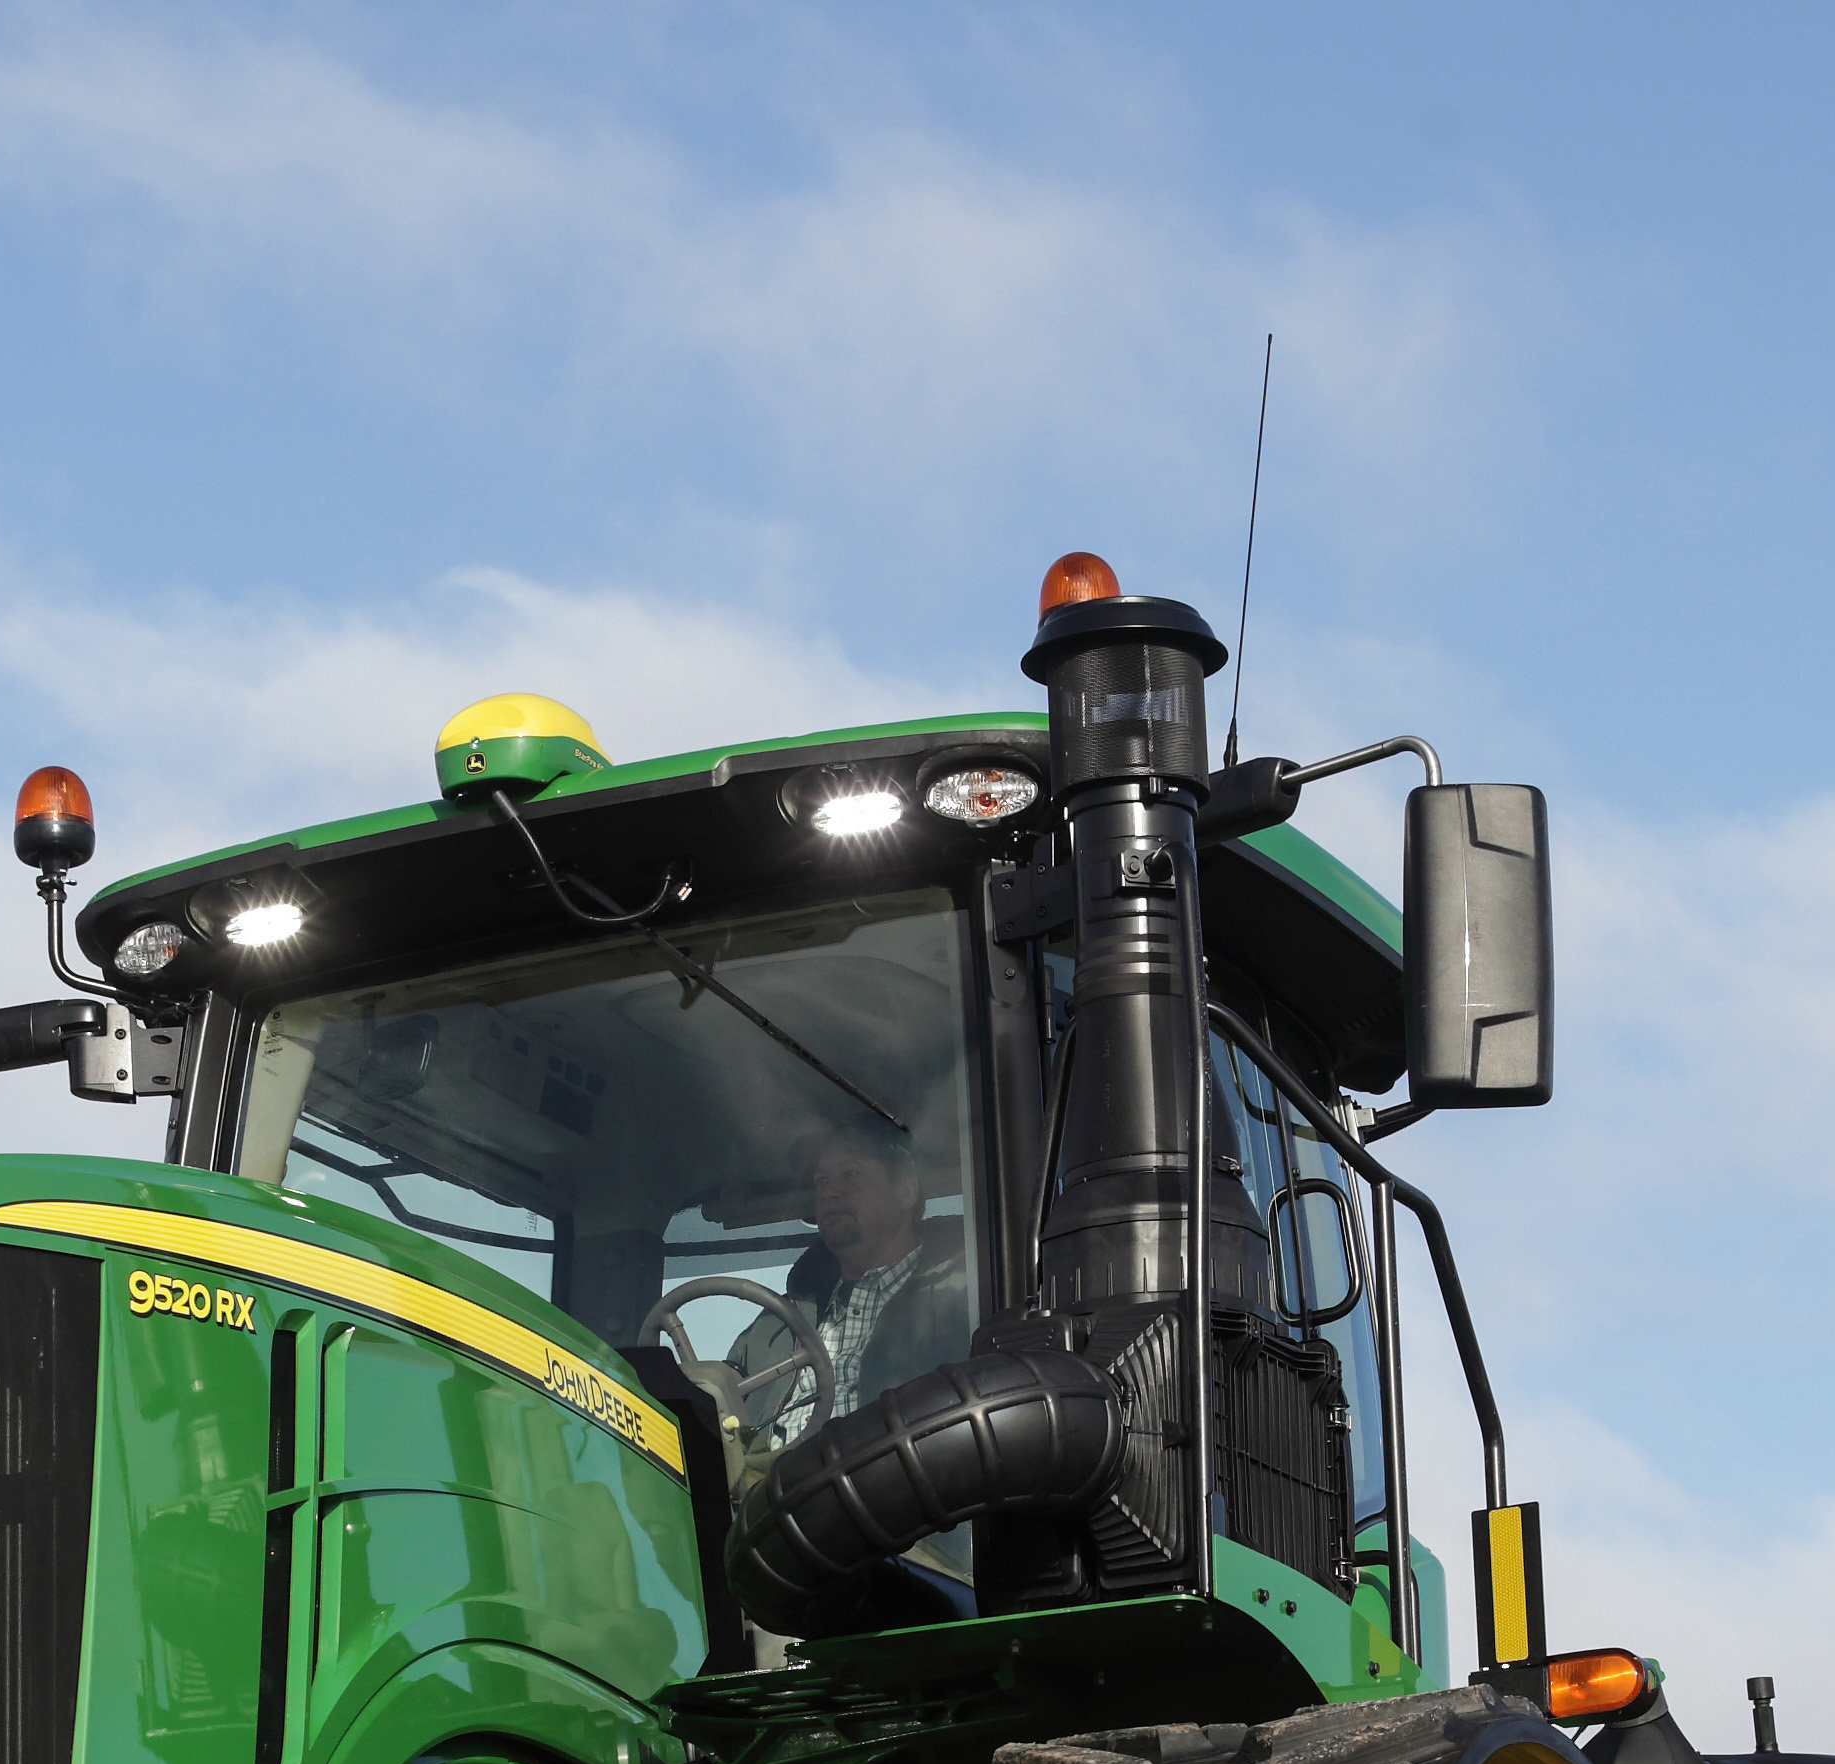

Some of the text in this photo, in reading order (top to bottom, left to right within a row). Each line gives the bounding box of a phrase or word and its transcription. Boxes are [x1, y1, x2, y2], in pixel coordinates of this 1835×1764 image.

[128, 1270, 256, 1333] 9520 RX
[543, 1347, 647, 1448] JOHN DEERE
